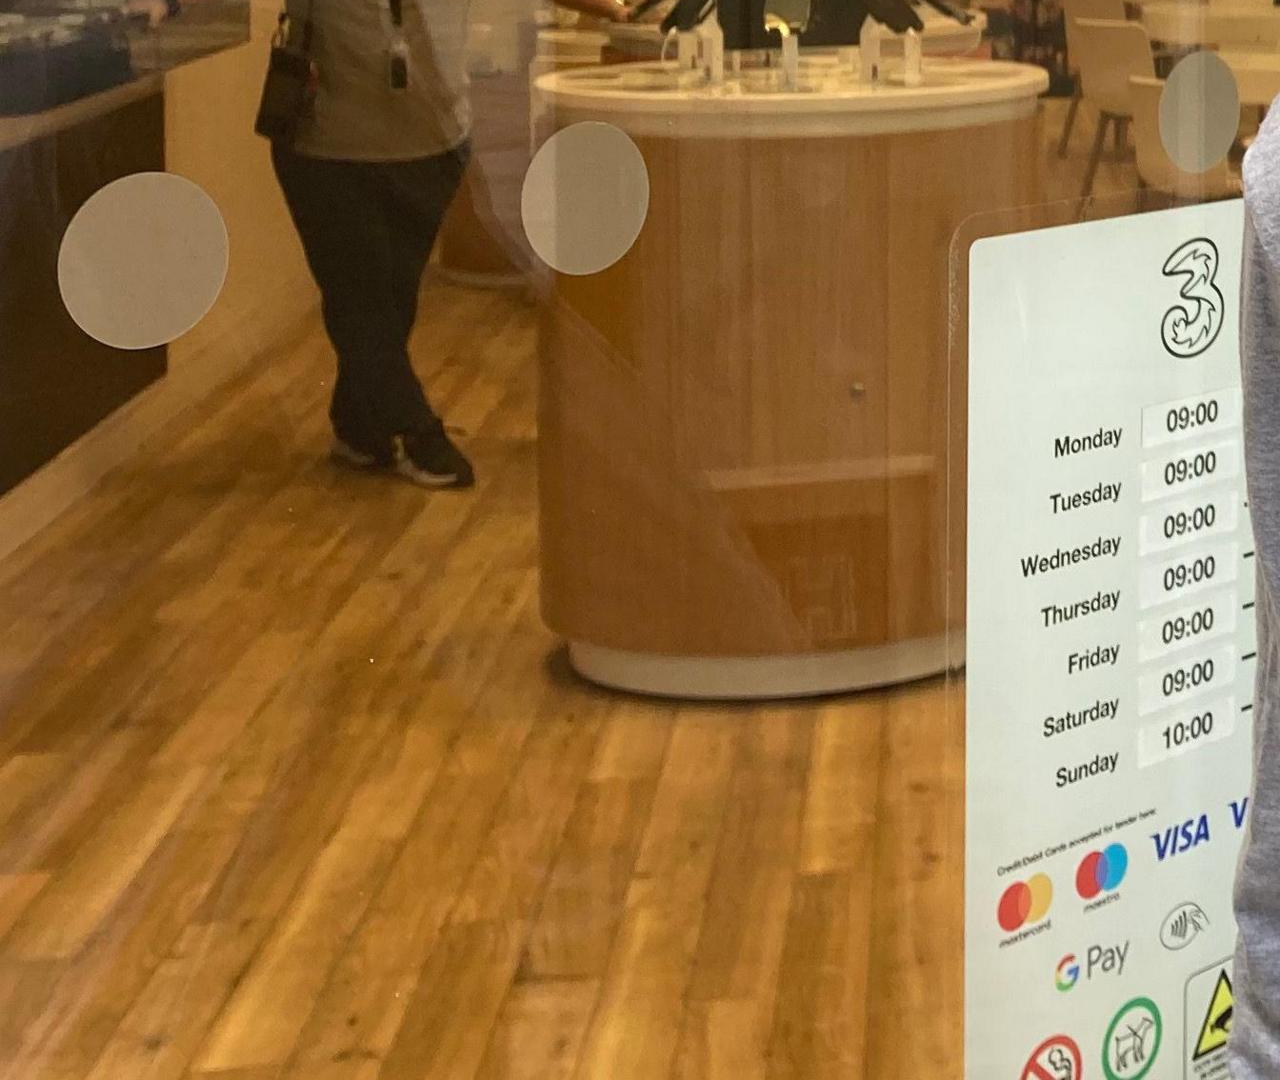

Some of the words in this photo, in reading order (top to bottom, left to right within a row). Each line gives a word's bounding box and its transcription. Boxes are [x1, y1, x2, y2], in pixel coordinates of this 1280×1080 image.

[1054, 427, 1122, 458] Monday
[1166, 400, 1218, 432] 09:00
[1049, 482, 1121, 514] Tuesday
[1164, 451, 1216, 485] 09:00
[1020, 536, 1121, 578] Wednesday
[1164, 504, 1215, 538] 09:00
[1040, 590, 1120, 627] Thursday
[1164, 556, 1215, 591] 09:00
[1068, 644, 1120, 674] Friday
[1162, 608, 1213, 644] 09:00
[1043, 698, 1119, 738] Saturday
[1162, 659, 1213, 696] 09:00
[1055, 752, 1119, 788] Sunday
[1162, 712, 1213, 749] 10:00
[1045, 843, 1067, 858] Cards
[1069, 827, 1102, 848] accepted
[1150, 814, 1210, 861] VISA
[1083, 892, 1120, 914] maestro
[998, 919, 1051, 948] mastercard
[1086, 939, 1130, 980] Pay
